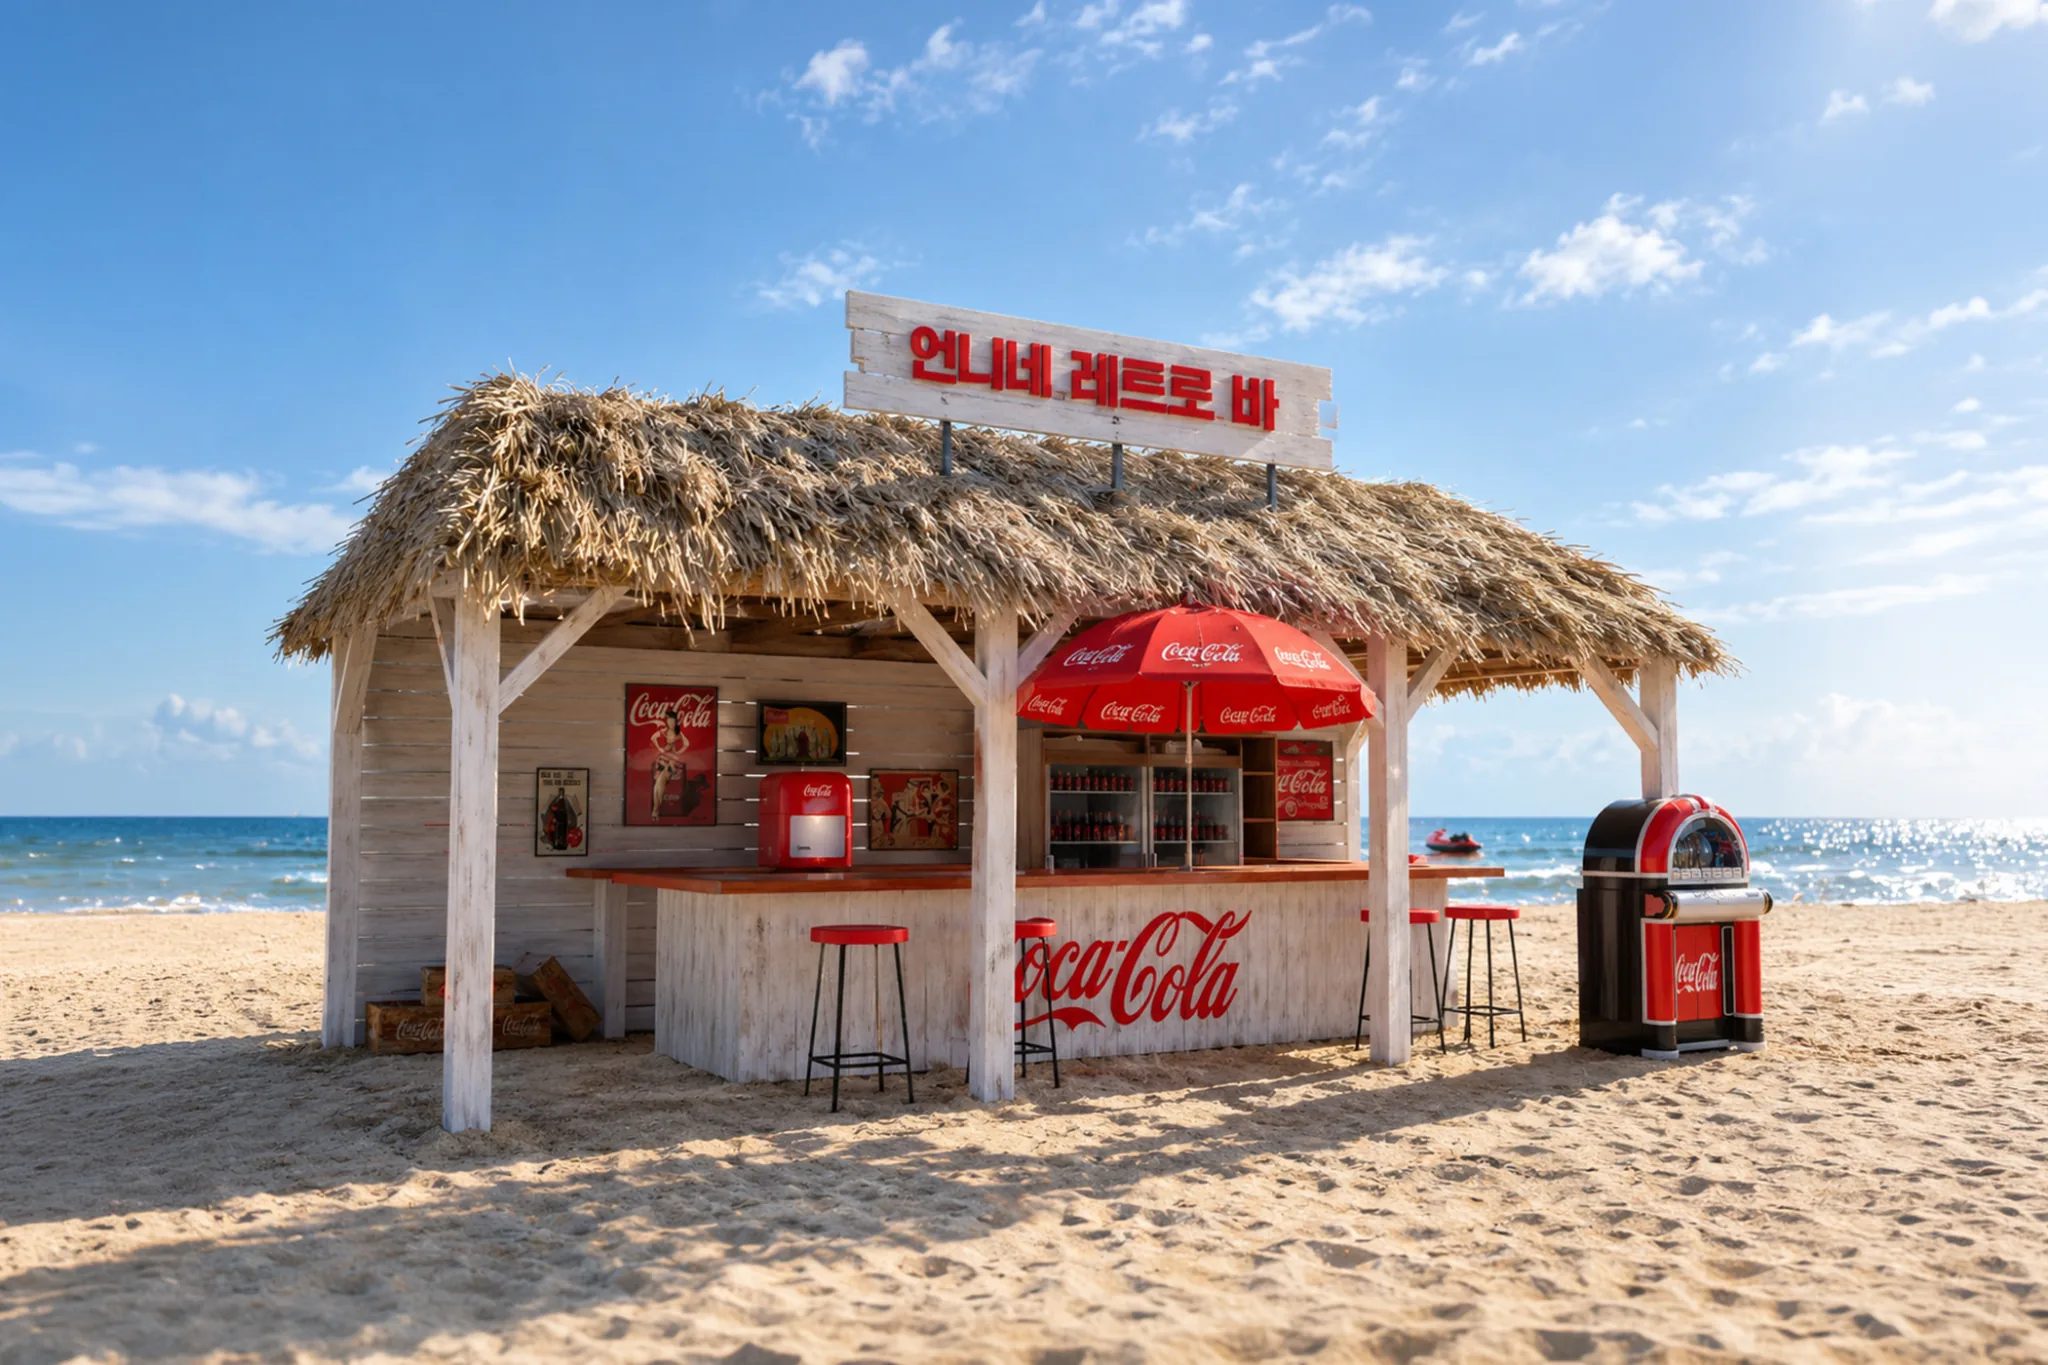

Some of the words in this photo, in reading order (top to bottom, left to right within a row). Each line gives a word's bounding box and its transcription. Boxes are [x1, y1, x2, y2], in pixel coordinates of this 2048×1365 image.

[910, 326, 1052, 398] 언니네
[1071, 350, 1215, 421] 레트로
[1232, 375, 1280, 431] 바
[1015, 910, 1252, 1031] oca-Cola
